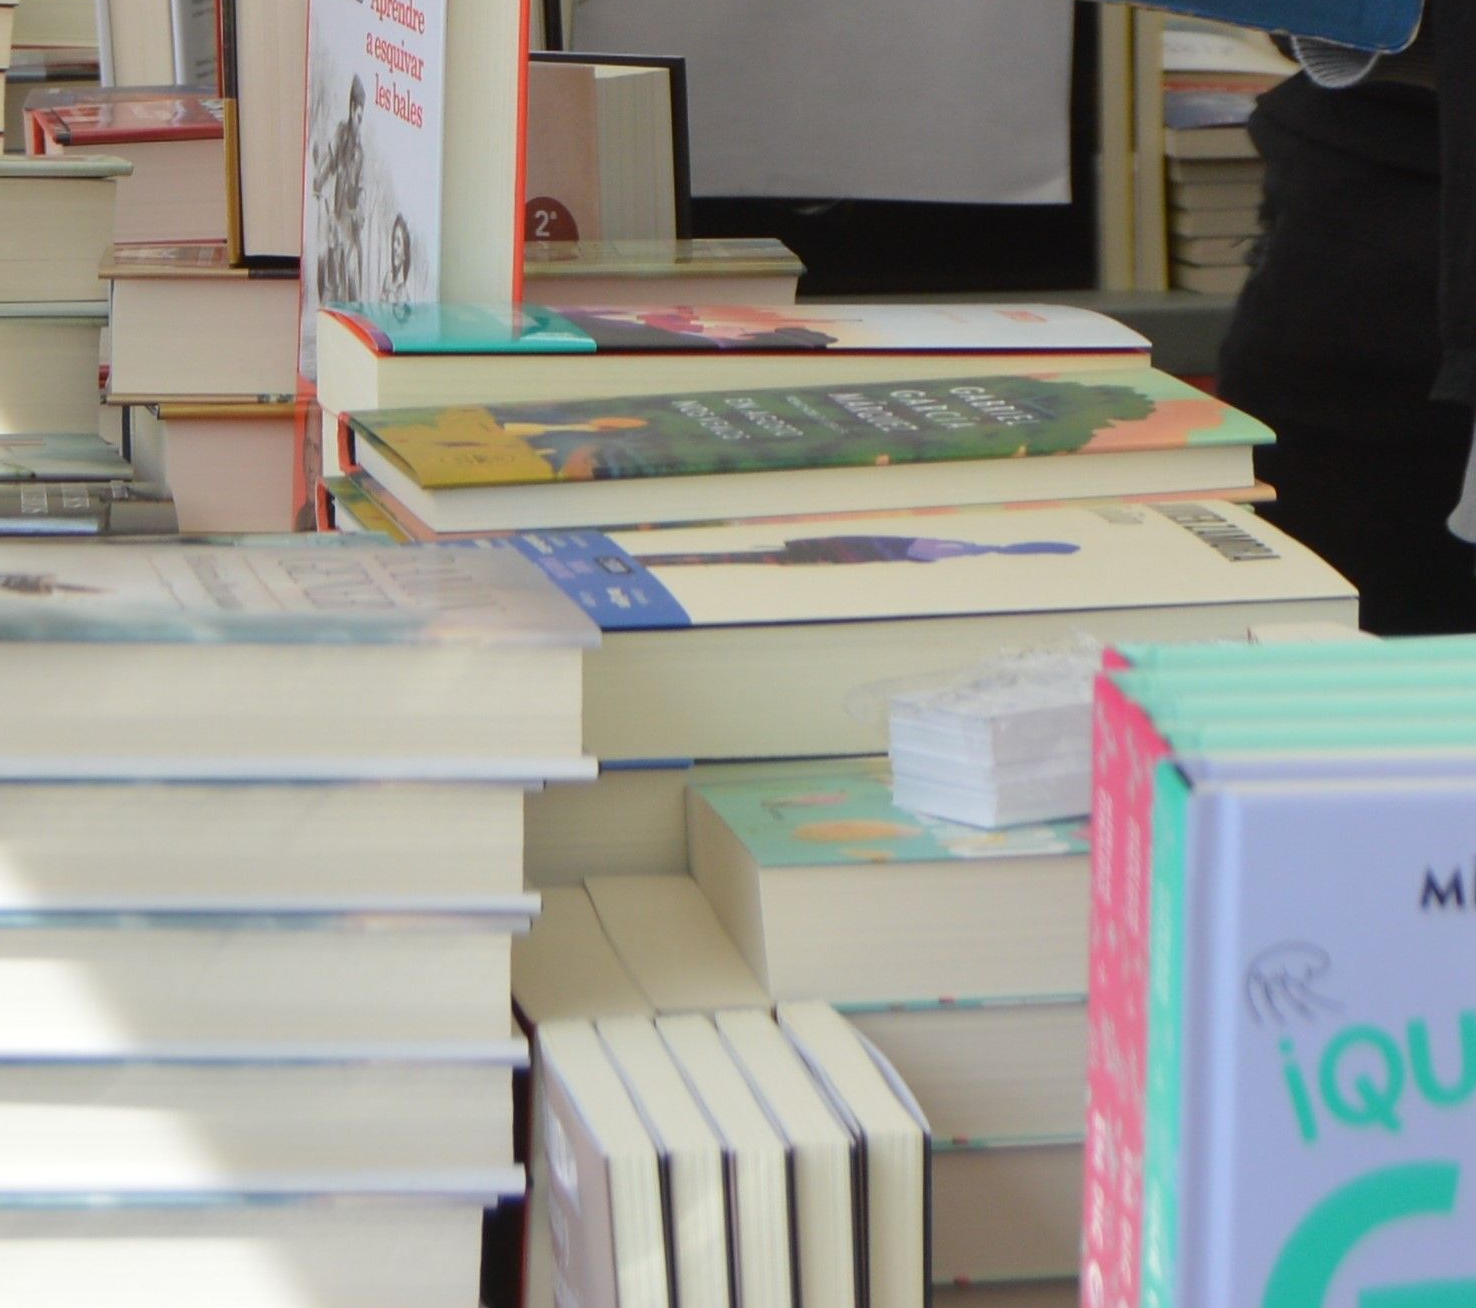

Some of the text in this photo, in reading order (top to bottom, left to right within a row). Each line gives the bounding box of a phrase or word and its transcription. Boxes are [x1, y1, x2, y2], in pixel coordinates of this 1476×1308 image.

[366, 32, 424, 82] a esquivar
[375, 72, 423, 129] les bales
[949, 386, 1041, 426] GABRIEL
